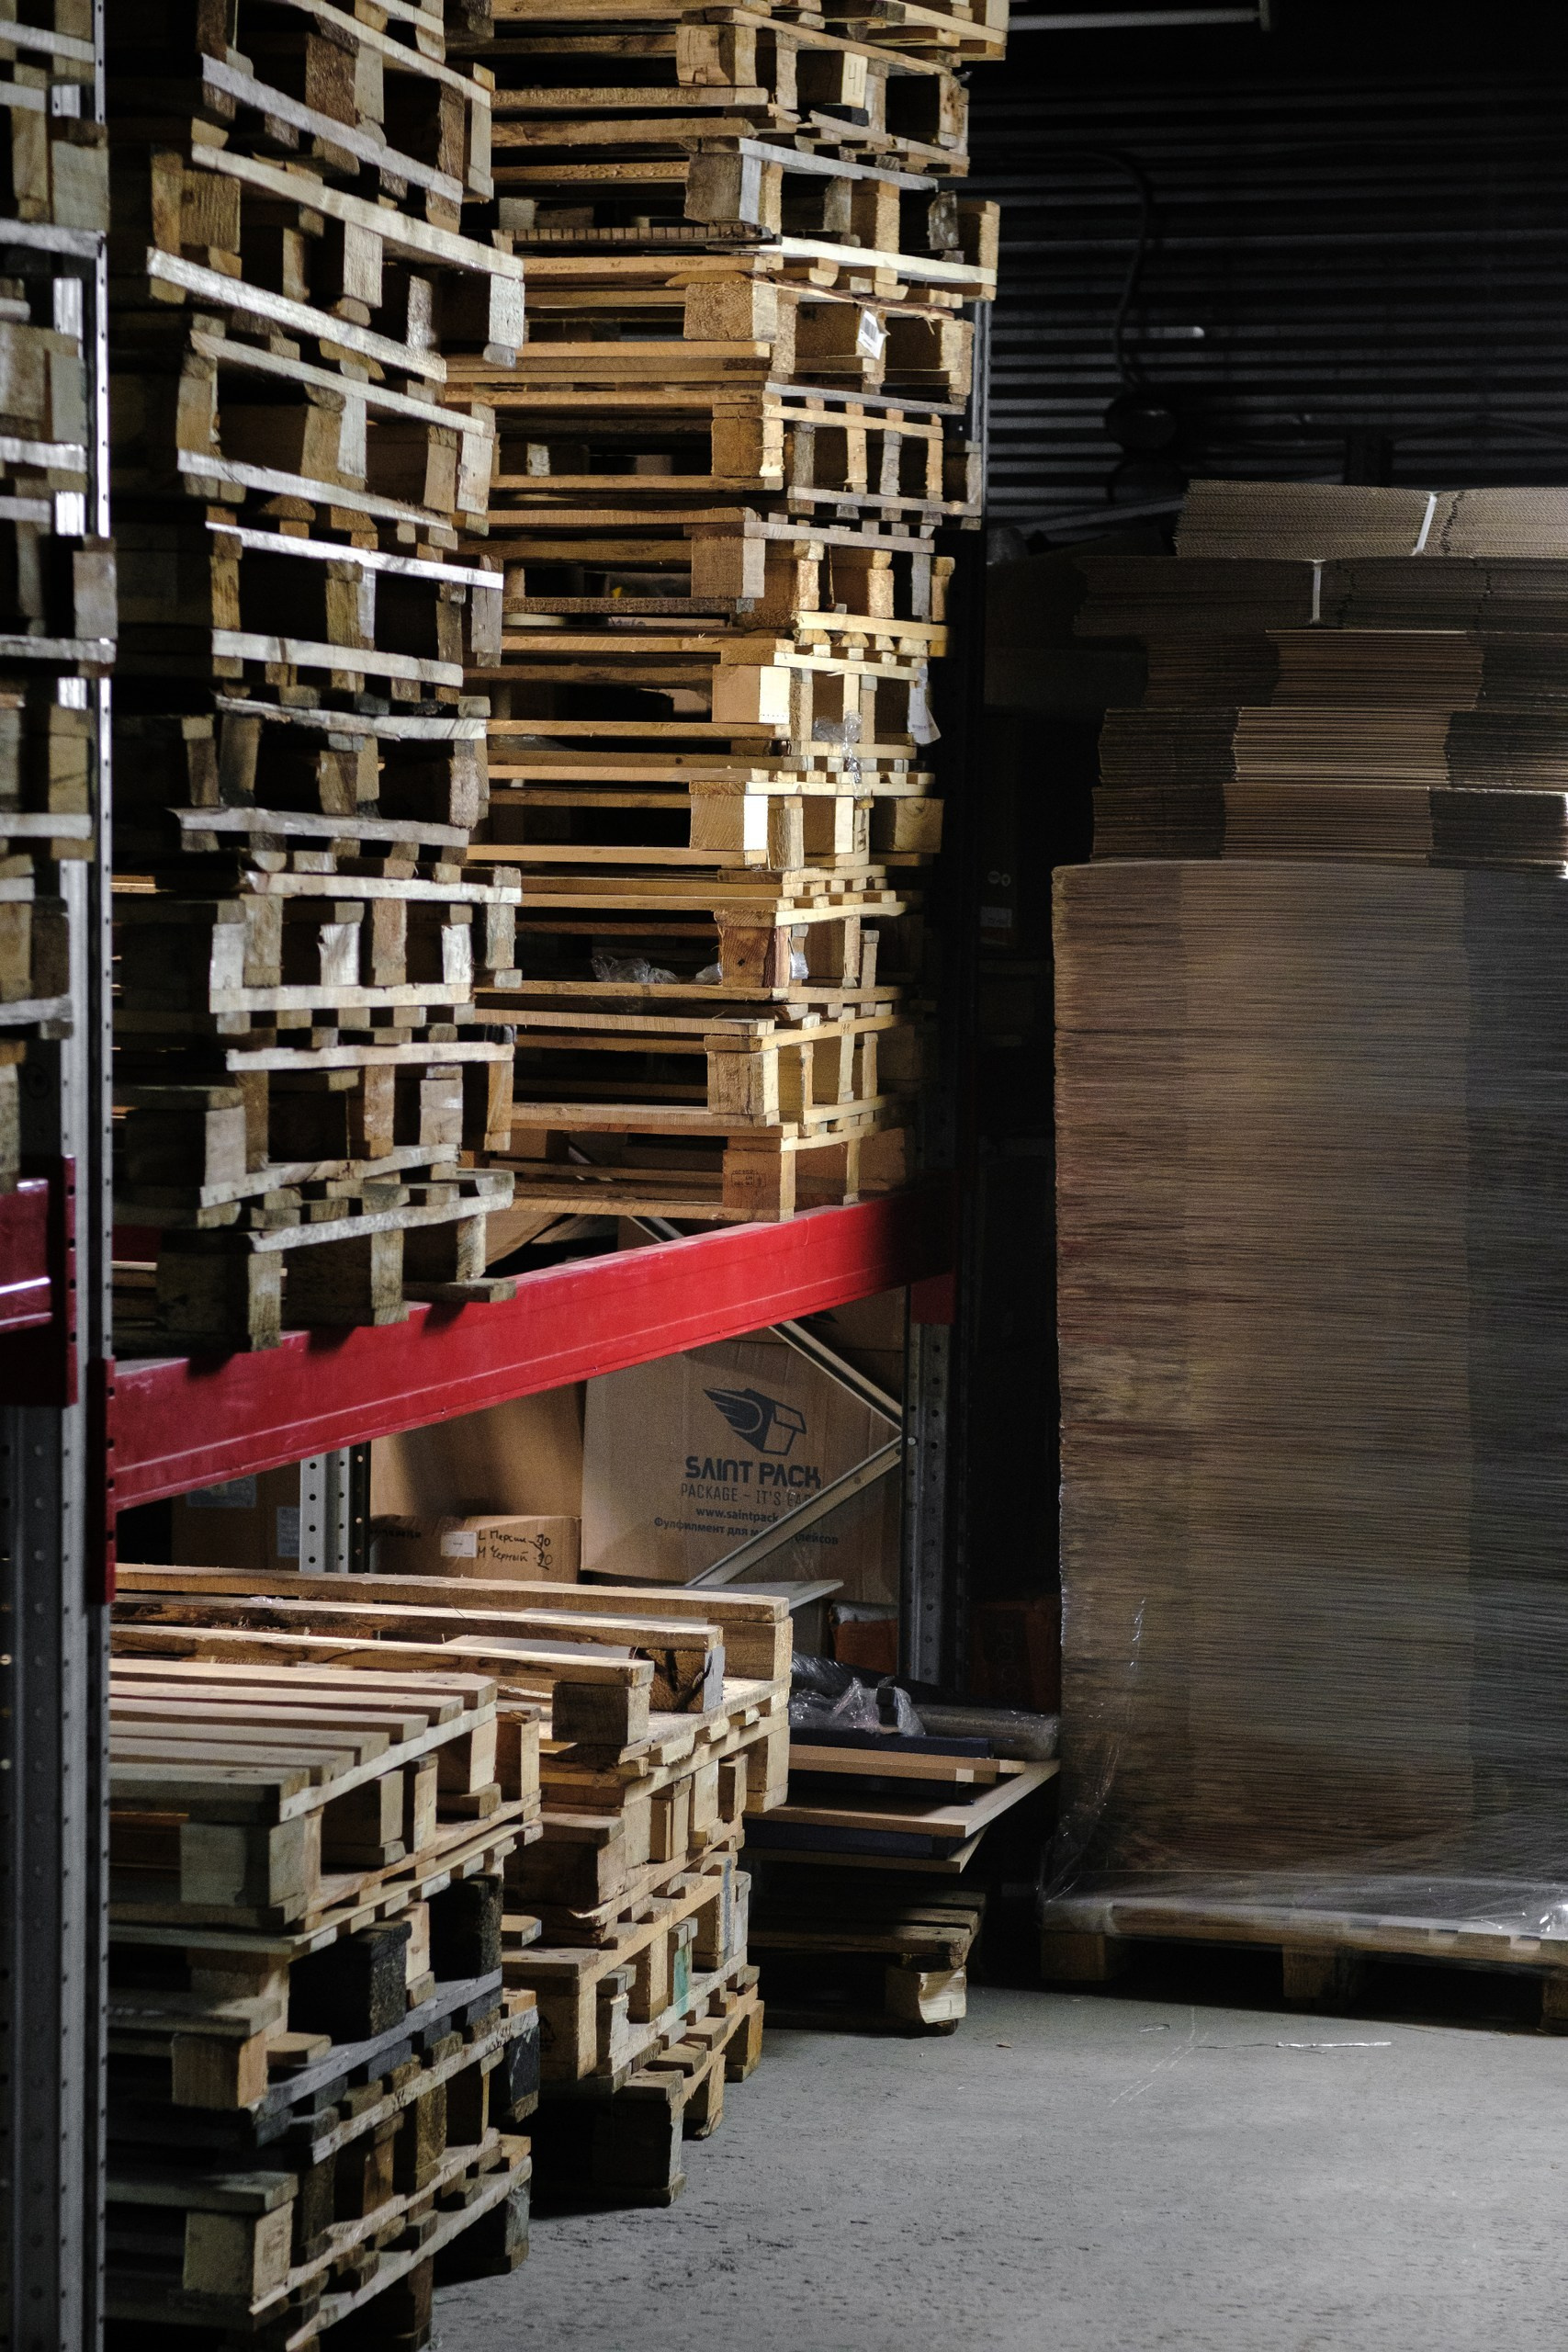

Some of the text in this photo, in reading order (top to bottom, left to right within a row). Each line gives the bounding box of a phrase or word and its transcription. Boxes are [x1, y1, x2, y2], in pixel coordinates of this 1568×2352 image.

[685, 1455, 821, 1488] SAINT PACK
[681, 1483, 738, 1502] PACKAGE
[756, 1489, 781, 1506] IT'S
[787, 1493, 812, 1507] EA
[696, 1509, 779, 1524] www.saintpack
[478, 1530, 486, 1540] L
[727, 1527, 748, 1536] для
